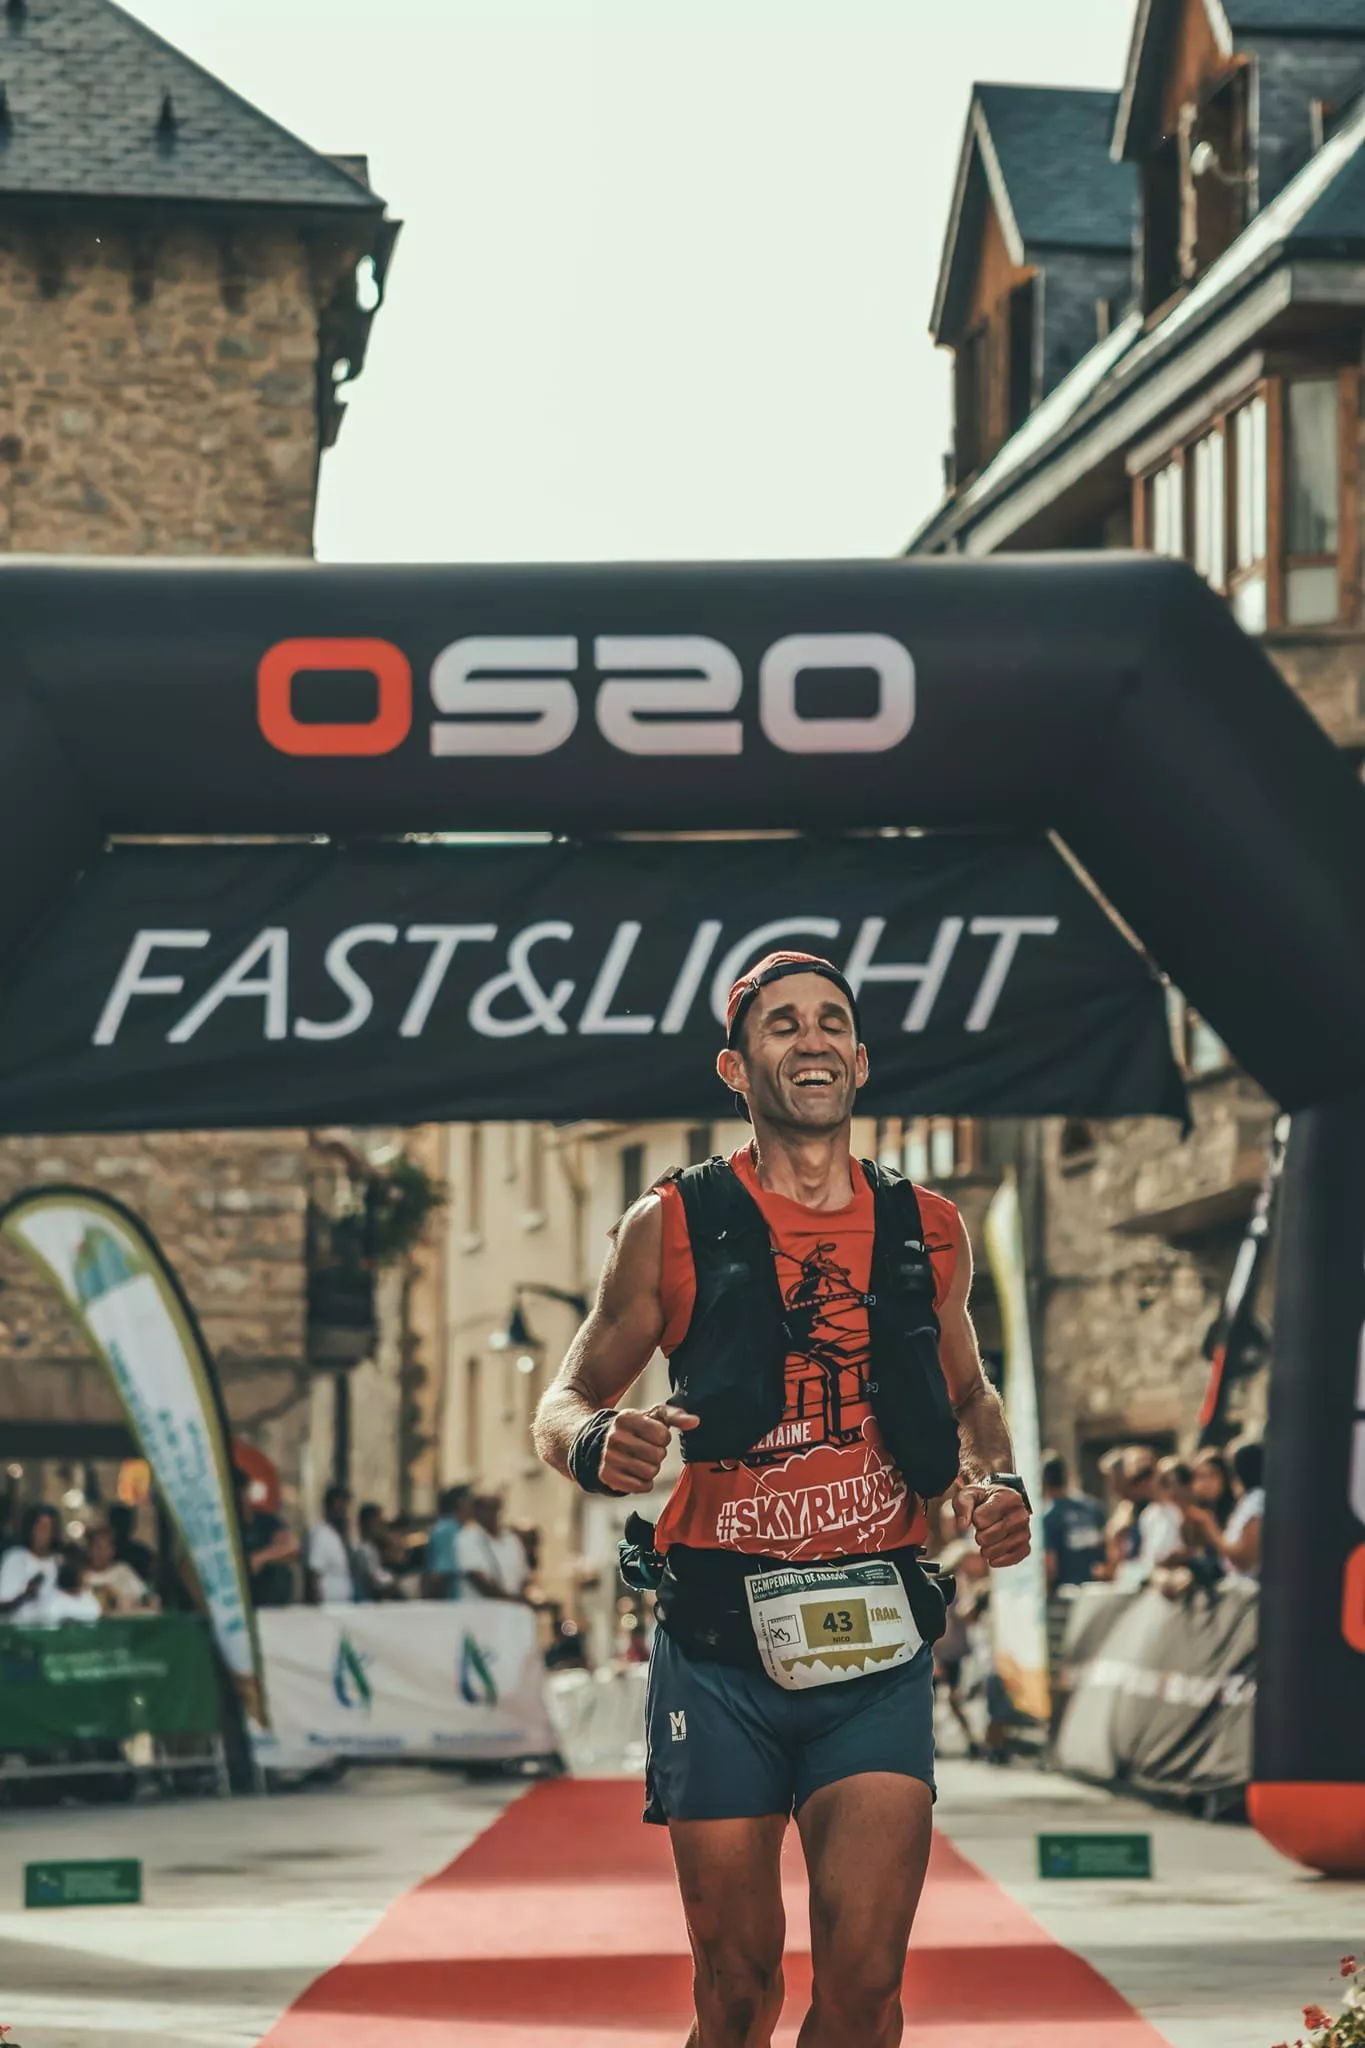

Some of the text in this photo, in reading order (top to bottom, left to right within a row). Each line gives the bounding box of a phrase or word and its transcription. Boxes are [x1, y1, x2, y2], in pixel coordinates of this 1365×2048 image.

[752, 1573, 804, 1594] CAMPEONATO
[805, 1572, 817, 1585] DE
[823, 1611, 853, 1633] 43
